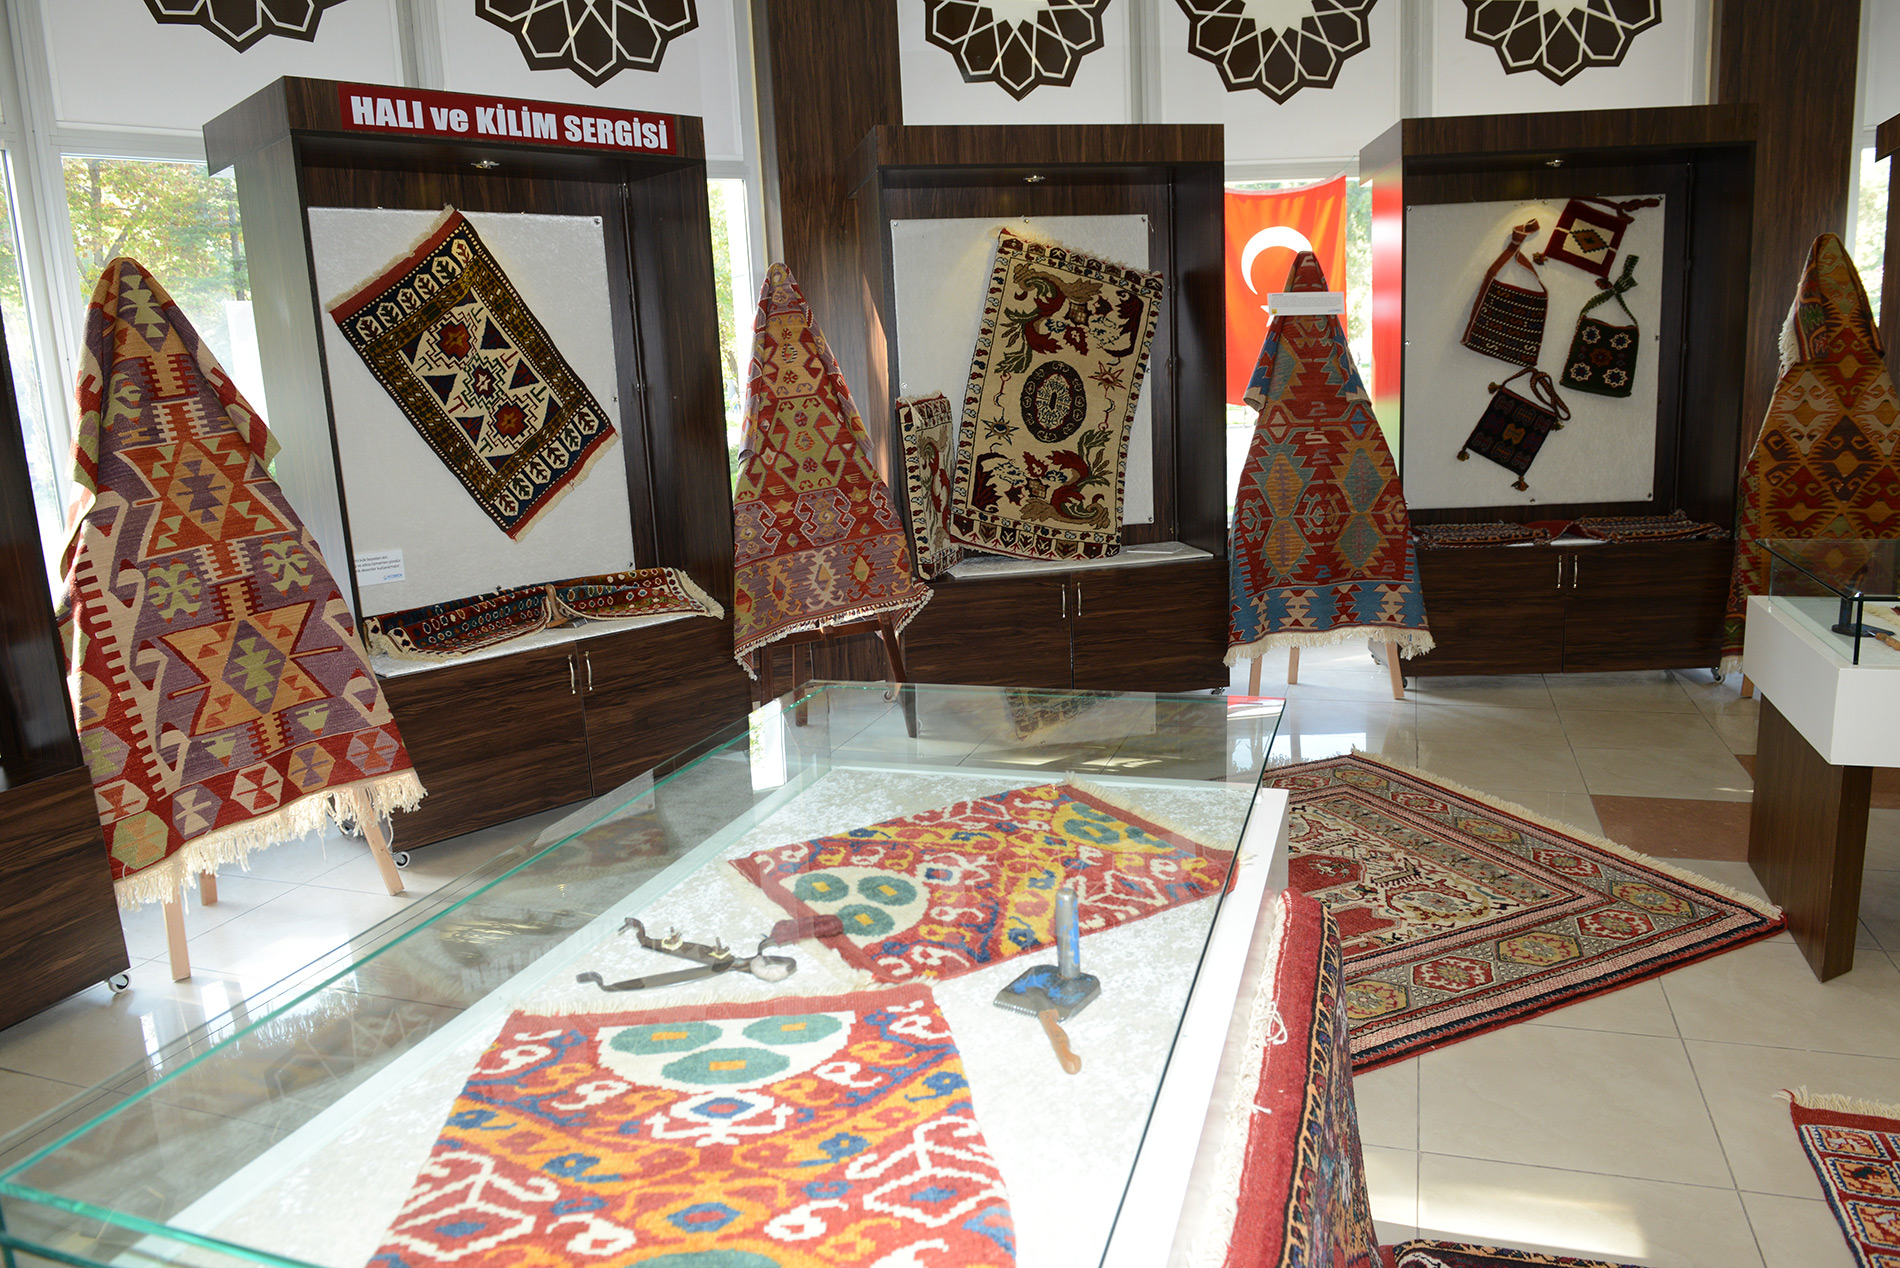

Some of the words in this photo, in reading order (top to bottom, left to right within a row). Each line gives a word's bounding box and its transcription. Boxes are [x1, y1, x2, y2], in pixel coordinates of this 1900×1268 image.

[350, 95, 425, 129] HALI
[430, 106, 470, 132] ve
[476, 103, 559, 140] KİLİM
[563, 114, 669, 150] SERGİSİ
